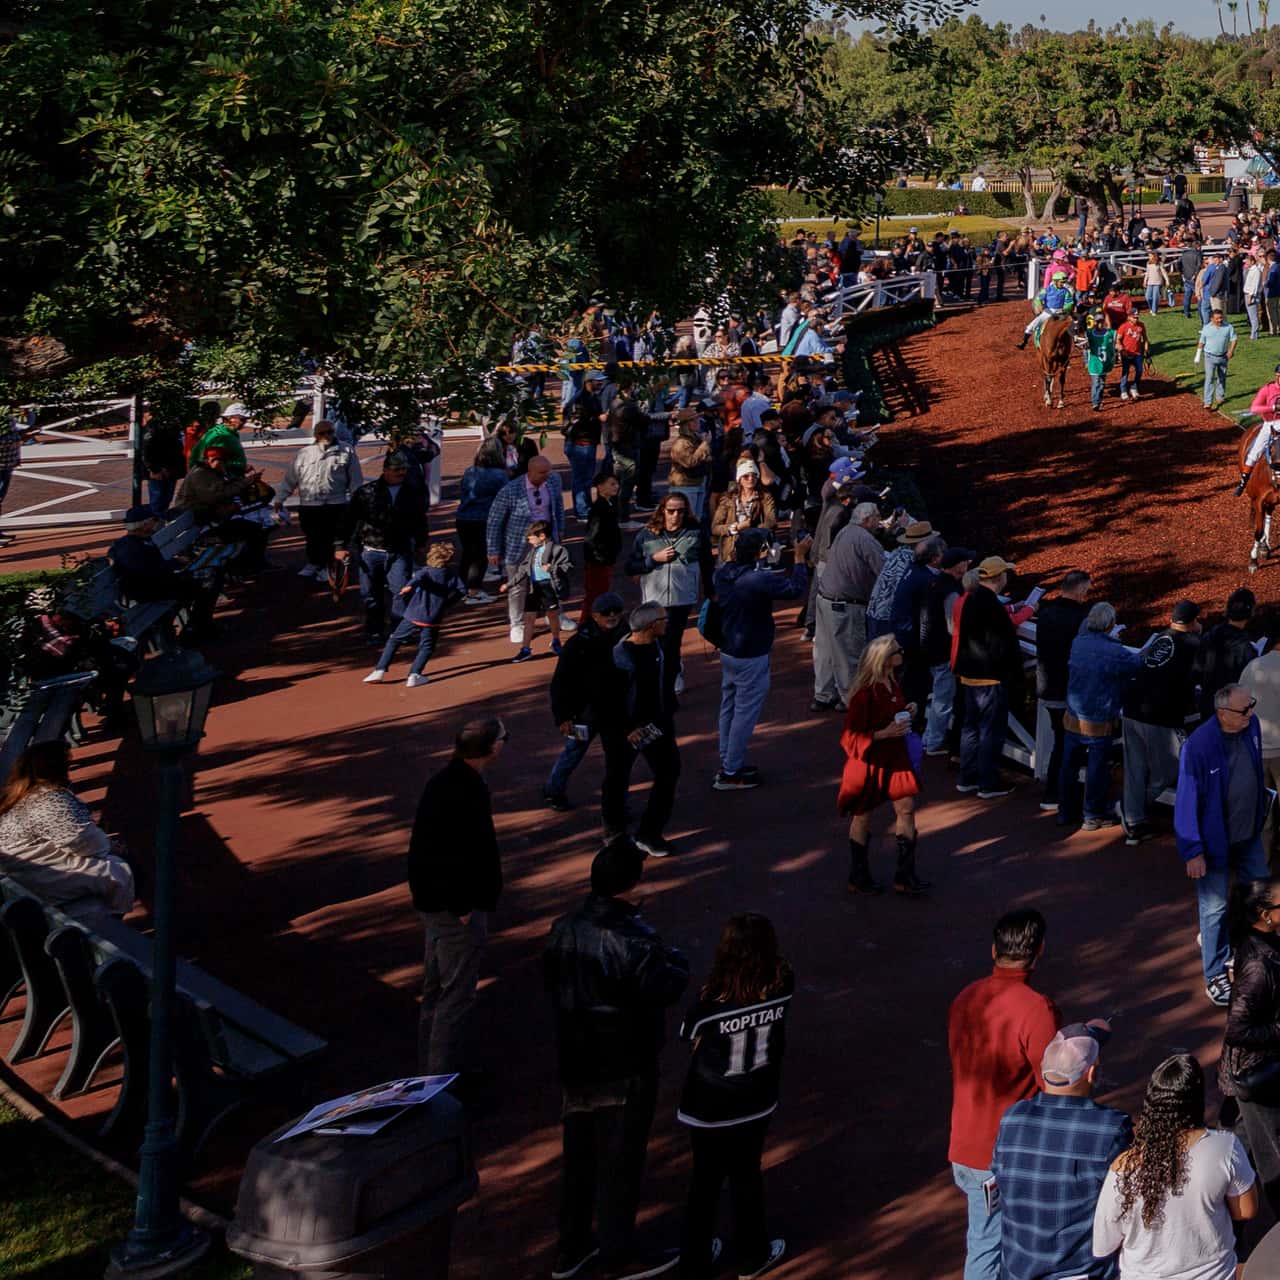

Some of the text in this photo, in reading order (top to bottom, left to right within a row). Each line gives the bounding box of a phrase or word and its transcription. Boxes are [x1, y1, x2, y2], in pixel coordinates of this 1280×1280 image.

[1098, 346, 1107, 362] 5
[719, 1006, 785, 1034] KOPITAR
[723, 1023, 773, 1077] 11
